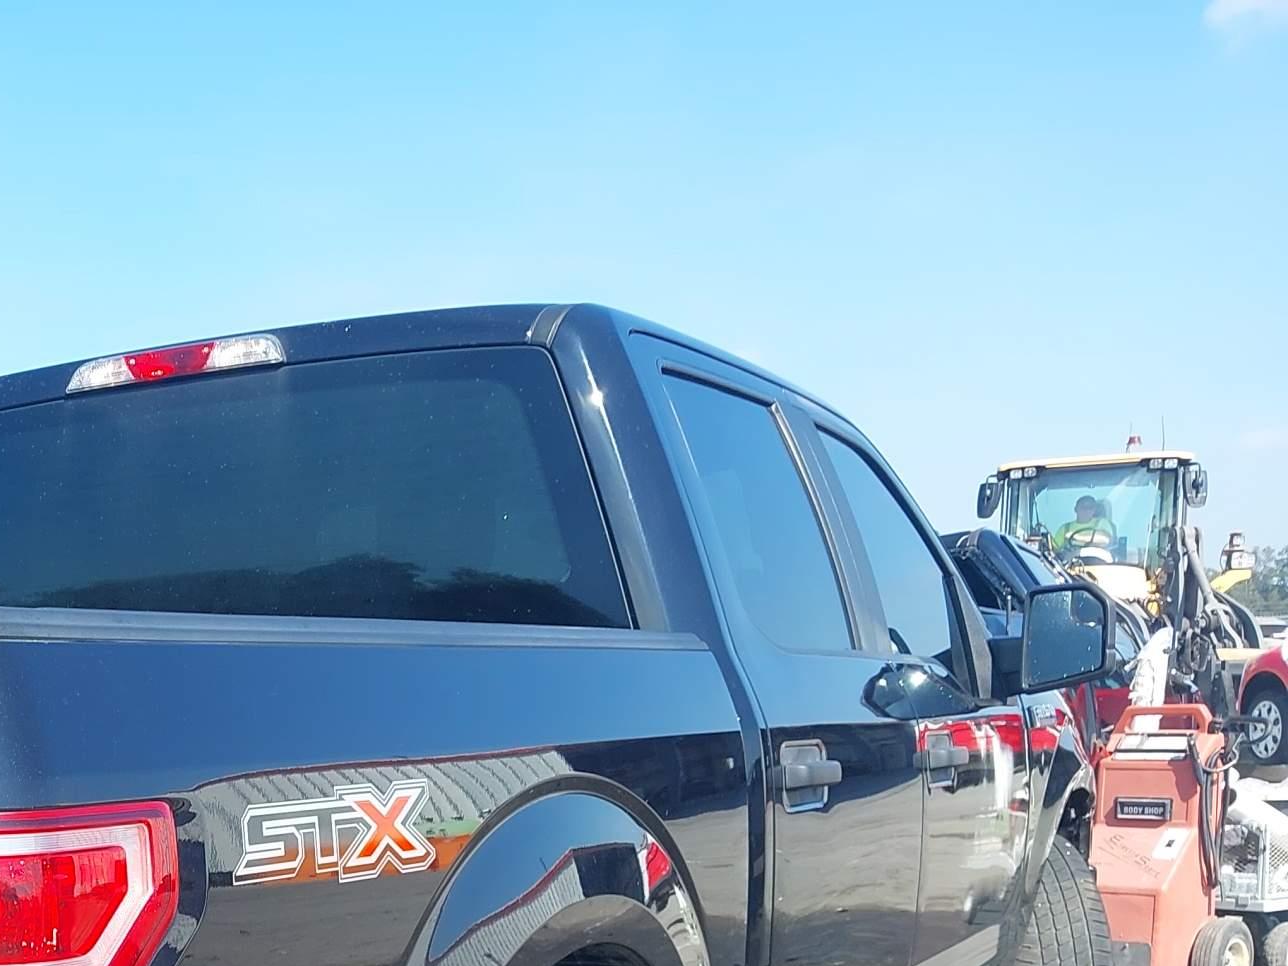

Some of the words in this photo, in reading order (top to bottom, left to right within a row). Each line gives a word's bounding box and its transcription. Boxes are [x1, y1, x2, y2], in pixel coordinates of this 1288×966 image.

[232, 778, 436, 886] STX
[1123, 806, 1143, 815] BODY
[1144, 806, 1164, 815] SHOP
